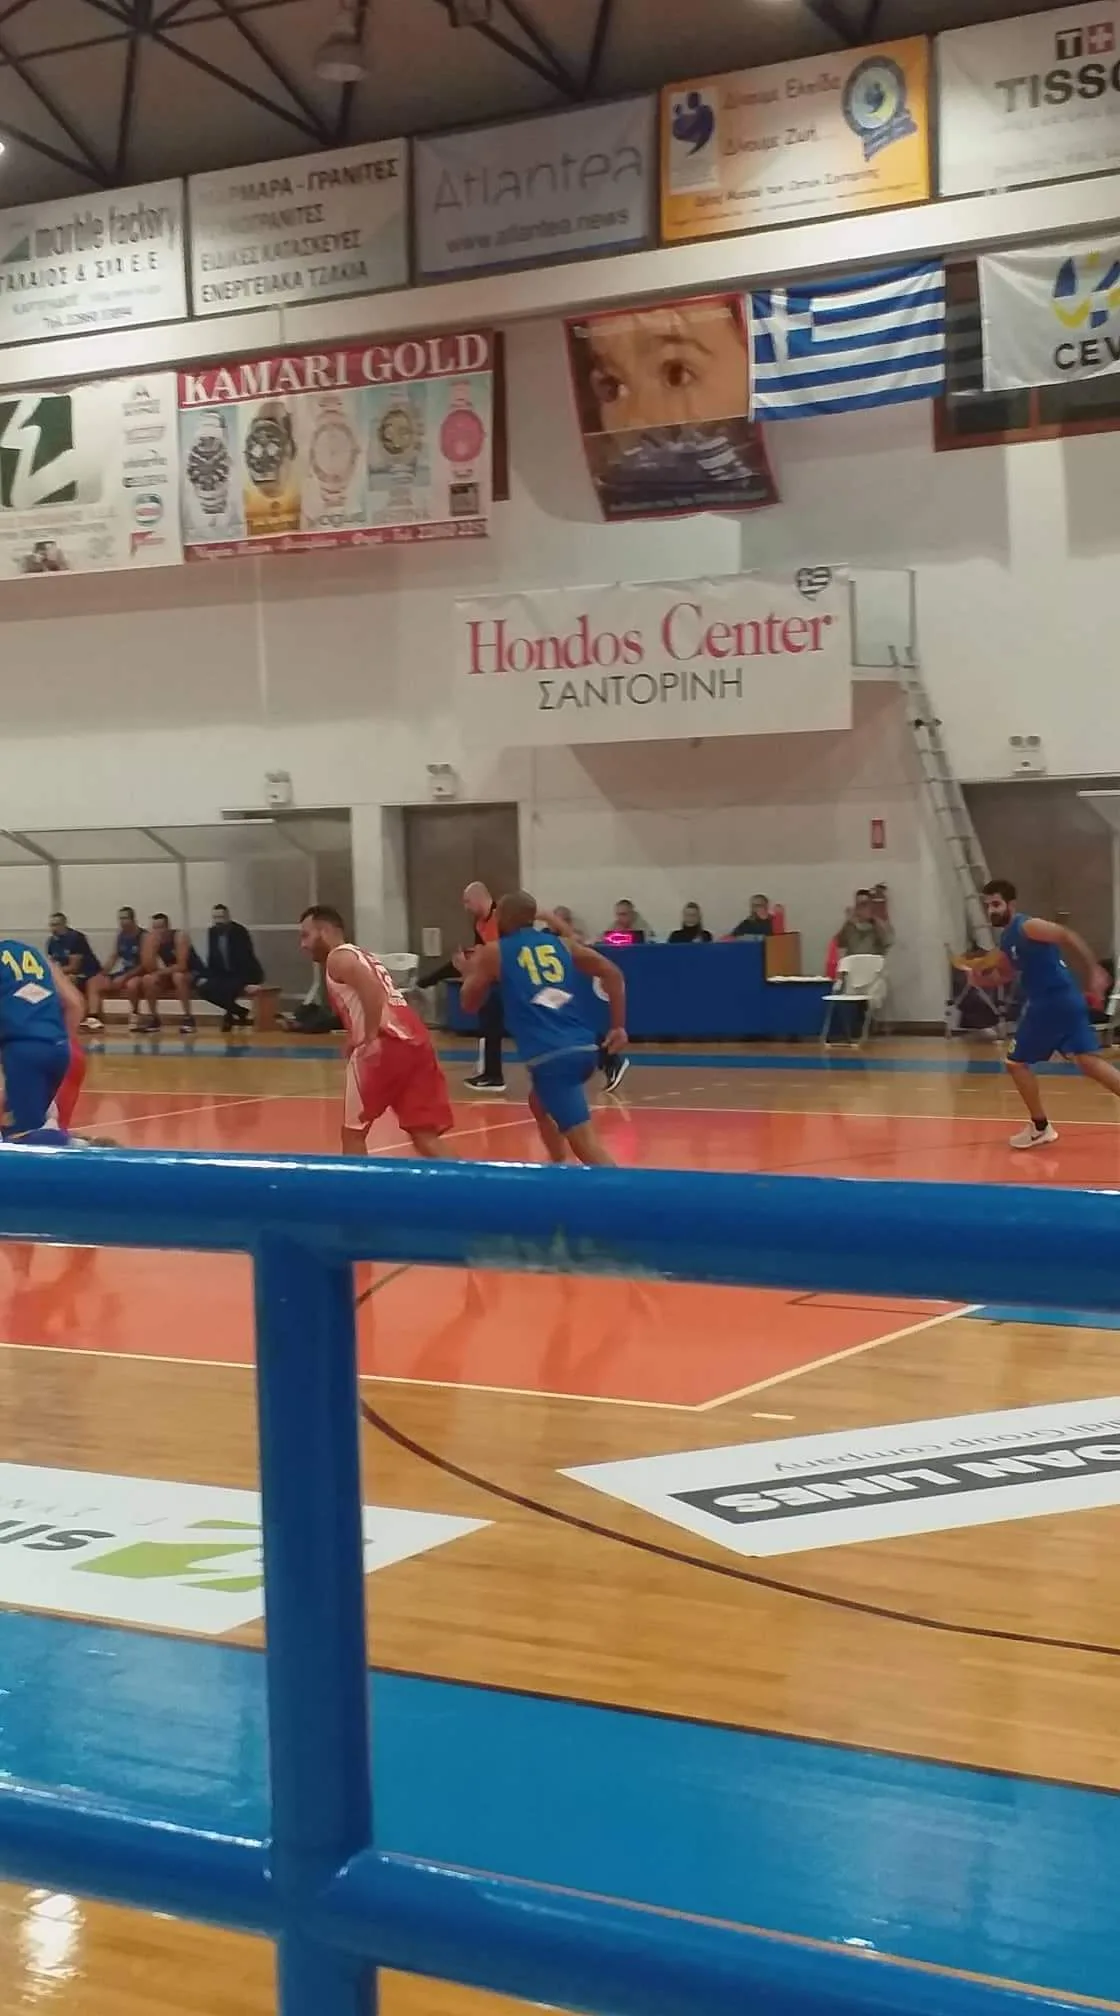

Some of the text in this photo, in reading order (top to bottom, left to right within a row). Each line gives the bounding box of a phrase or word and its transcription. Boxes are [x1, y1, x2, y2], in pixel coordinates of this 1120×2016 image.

[307, 158, 399, 191] ΓΡΑΝΙΤΕΣ
[434, 146, 642, 214] Atlantea
[201, 271, 304, 303] ΕΝΕΡΓΕΙΑΚΑ
[182, 333, 488, 405] KAMARI GOLD
[466, 602, 833, 675] Hondos Center
[538, 667, 744, 710] ΣΑΝΤΟΡΙΝΗ
[1, 949, 45, 982] 14
[517, 944, 565, 986] 15
[774, 1440, 942, 1472] company
[713, 1467, 961, 1513] LINES
